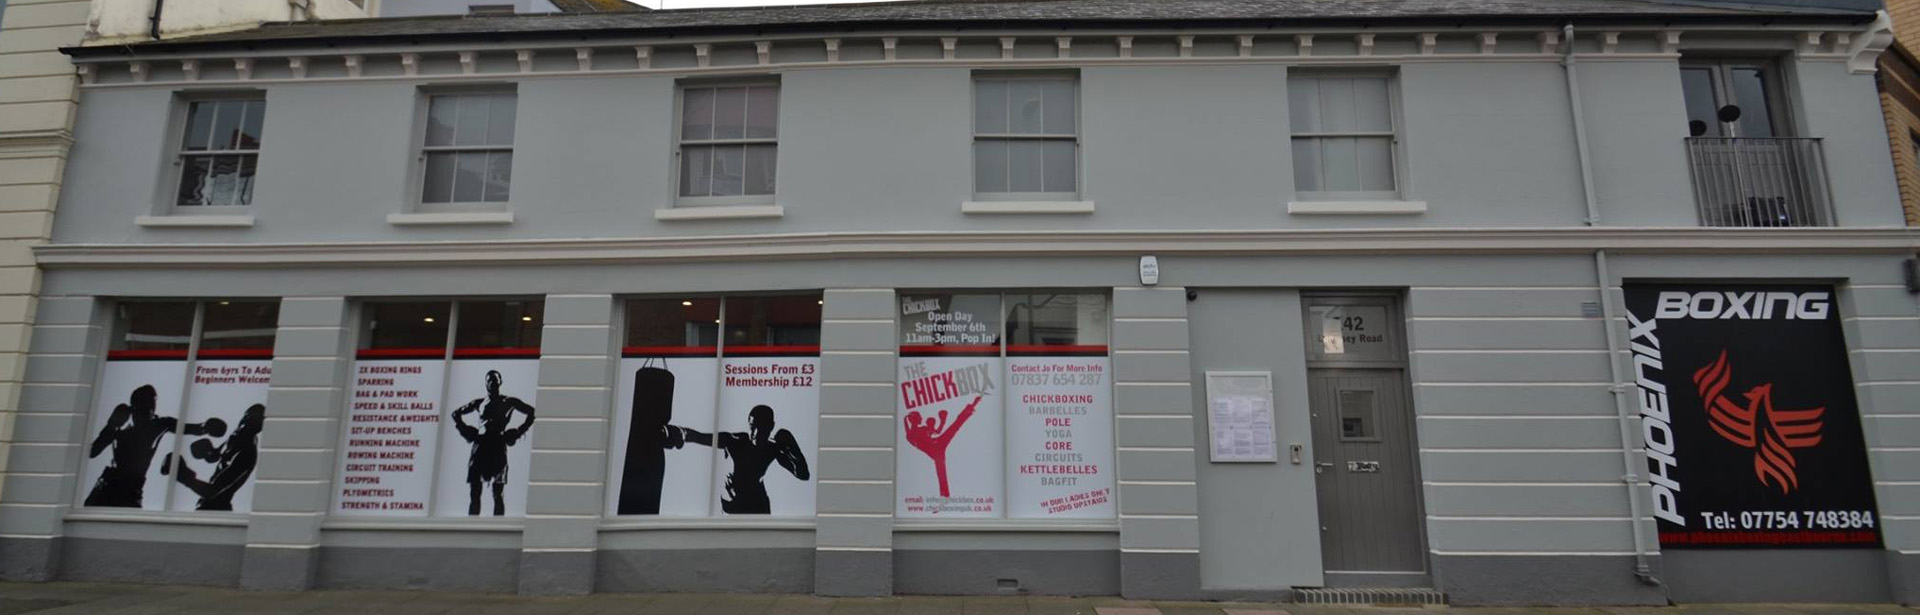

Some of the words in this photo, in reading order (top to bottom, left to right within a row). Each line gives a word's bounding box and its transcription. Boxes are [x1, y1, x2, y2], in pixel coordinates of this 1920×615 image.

[1655, 291, 1829, 320] BOXING
[928, 311, 952, 322] Open
[955, 311, 973, 322] Day
[915, 322, 966, 333] September
[969, 322, 986, 332] 6th
[906, 333, 959, 344] 11am-3pm,
[961, 333, 979, 344] Pop
[982, 333, 996, 343] In!
[1359, 334, 1383, 343] Road
[196, 366, 218, 374] From
[221, 366, 239, 375] 6yrs
[242, 366, 252, 374] To
[359, 366, 368, 374] 2X
[370, 366, 397, 374] BOXING
[399, 366, 422, 374] RINGS
[725, 364, 768, 374] Sessions
[771, 364, 798, 374] From
[801, 364, 814, 374] £3
[903, 361, 928, 379] THE
[1011, 364, 1040, 373] Contact
[1041, 365, 1050, 373] Jo
[1052, 364, 1065, 373] For
[1066, 364, 1086, 373] More
[1087, 364, 1103, 373] Info
[195, 376, 235, 384] Beginners
[357, 378, 394, 386] SPARRING
[725, 377, 789, 388] Membership
[792, 377, 812, 387] £12
[1011, 374, 1050, 386] 07837
[1052, 374, 1076, 386] 654
[1079, 374, 1103, 386] 287
[901, 362, 995, 410] CHICKBOX
[356, 390, 370, 398] BAG
[372, 390, 378, 398] &
[380, 390, 394, 398] PAD
[396, 390, 418, 398] WORK
[1022, 394, 1094, 404] CHICKBOXING
[354, 402, 378, 410] SPEED
[380, 402, 386, 410] &
[387, 402, 408, 410] SKILL
[410, 402, 433, 410] BALLS
[1029, 406, 1087, 415] BARBELLES
[352, 414, 398, 422] RESISTANCE
[1045, 418, 1071, 427] POLE
[1626, 309, 1686, 527] PHOENIX
[351, 427, 375, 435] SIT-UP
[377, 427, 412, 435] BENCHES
[1045, 429, 1072, 438] YOGA
[349, 439, 383, 447] RUNNING
[385, 439, 420, 447] MACHINE
[1045, 441, 1072, 450] CORE
[348, 451, 378, 460] ROWING
[379, 451, 414, 460] MACHINE
[1034, 453, 1083, 462] CIRCUITS
[346, 464, 377, 472] CIRCUIT
[378, 464, 414, 472] TRAINING
[1020, 465, 1098, 474] KETTLEBELLES
[345, 476, 380, 484] SKIPPING
[1041, 477, 1077, 486] BAGFIT
[343, 489, 394, 497] PLYOMETRICS
[1049, 497, 1063, 506] OUR
[1065, 492, 1090, 503] LADIES
[1091, 488, 1110, 498] ONLY
[341, 501, 380, 509] STRENGTH
[389, 502, 424, 510] STAMINA
[1048, 503, 1073, 514] STUDIO
[1073, 496, 1108, 509] UPSTAIRS
[1701, 511, 1736, 529] Tel:
[1741, 511, 1799, 529] 07754
[1803, 510, 1874, 529] 748384
